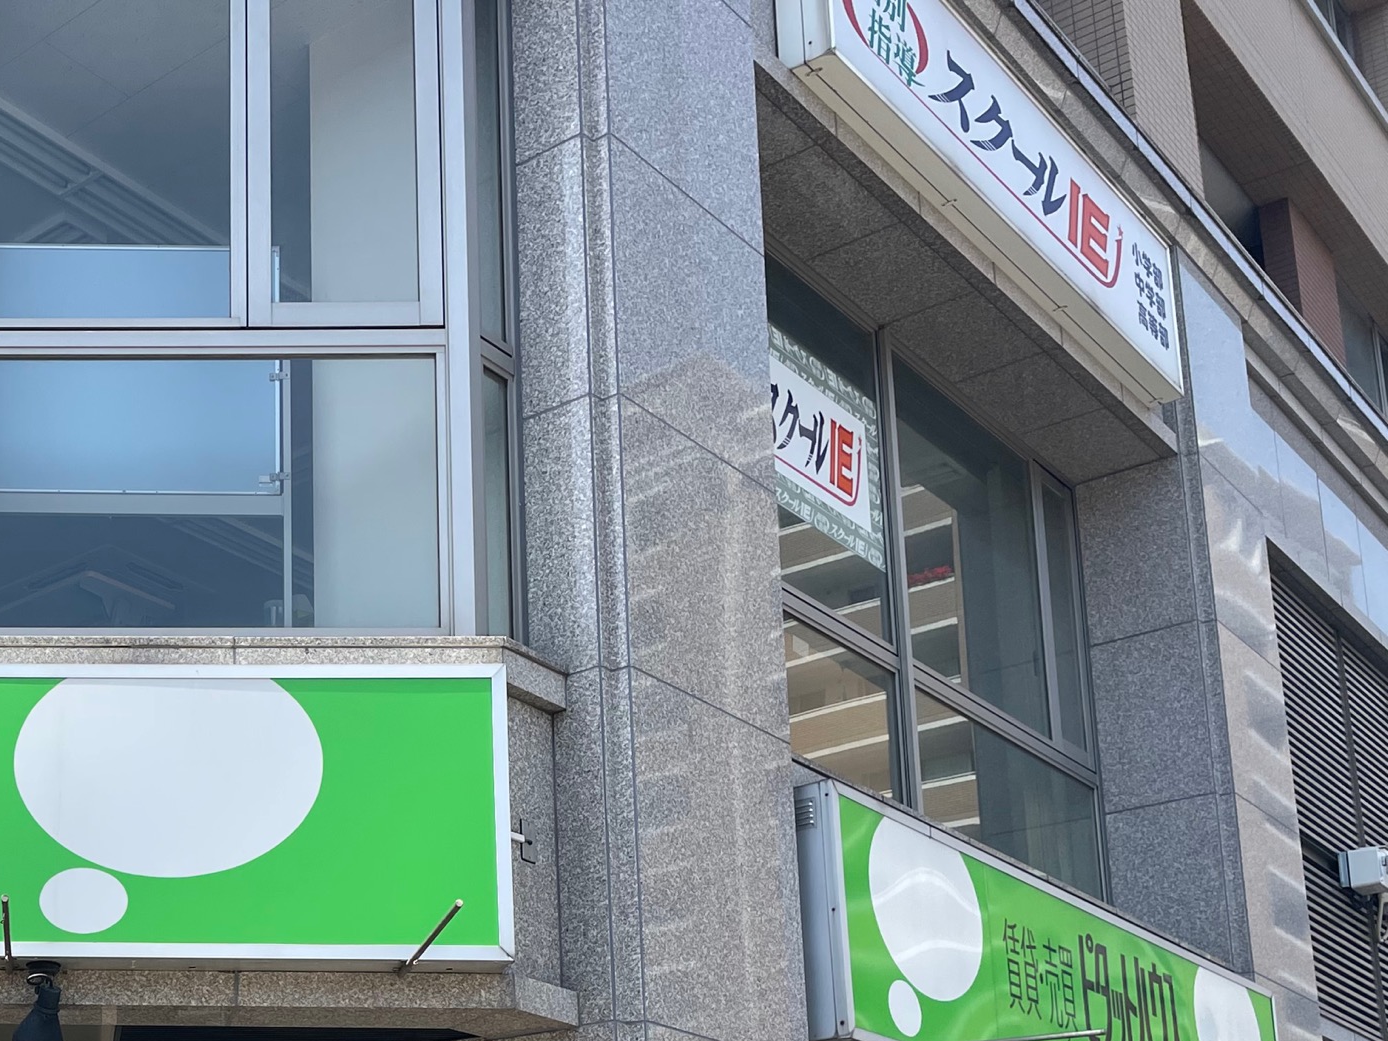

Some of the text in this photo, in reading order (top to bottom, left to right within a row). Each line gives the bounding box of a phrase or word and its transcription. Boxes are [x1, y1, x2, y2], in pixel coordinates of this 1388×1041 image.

[868, 8, 925, 87] 指導
[928, 50, 1110, 280] スクールIE
[1132, 242, 1163, 290] 小学部
[1002, 918, 1078, 1032] 賃貸・売買
